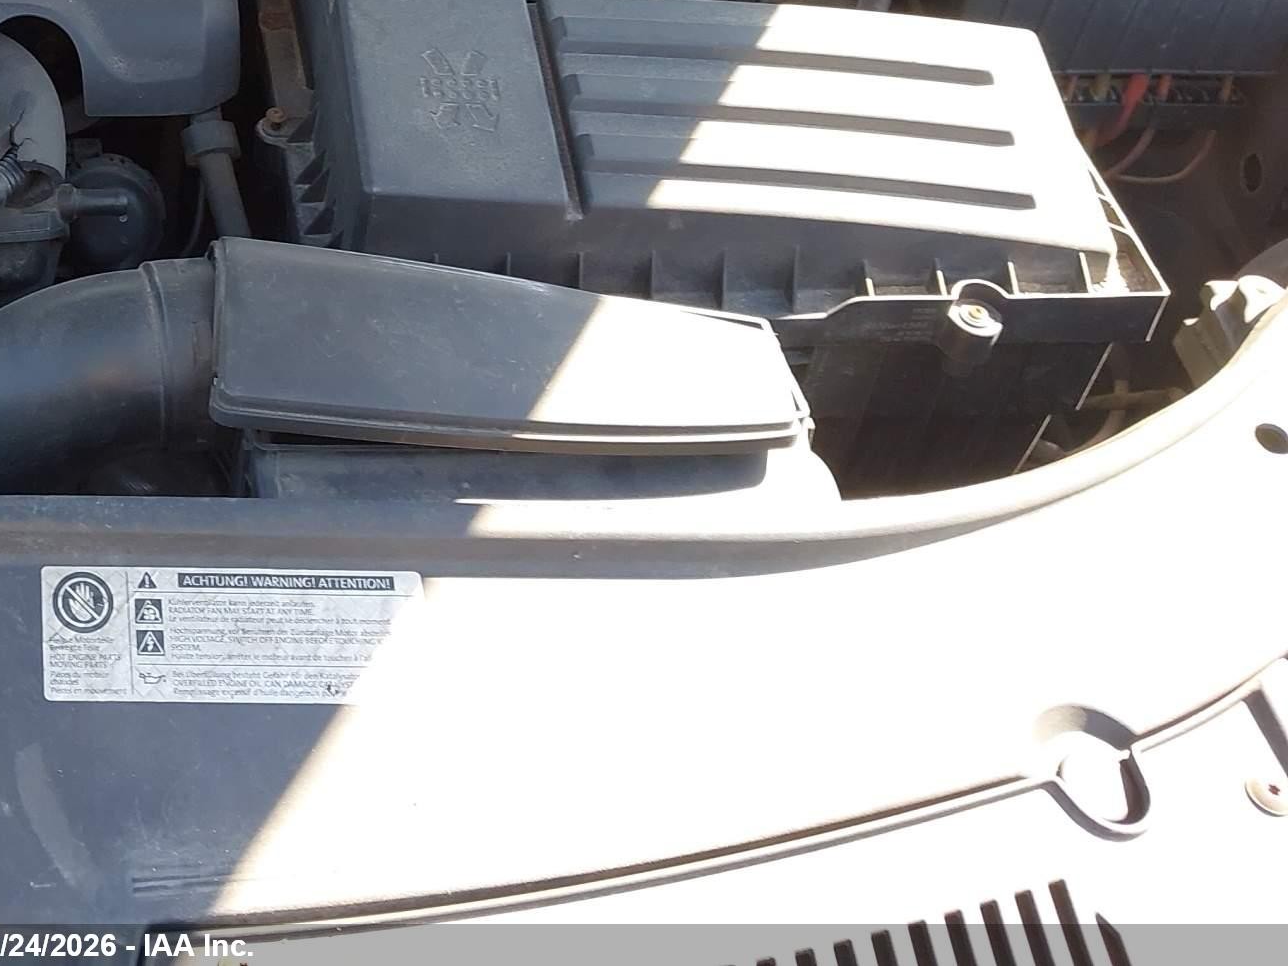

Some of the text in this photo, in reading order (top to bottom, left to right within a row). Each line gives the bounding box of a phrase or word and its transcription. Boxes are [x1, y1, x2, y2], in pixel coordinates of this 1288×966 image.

[182, 575, 391, 589] ACHTUNG! WARNING! ATTENTION!
